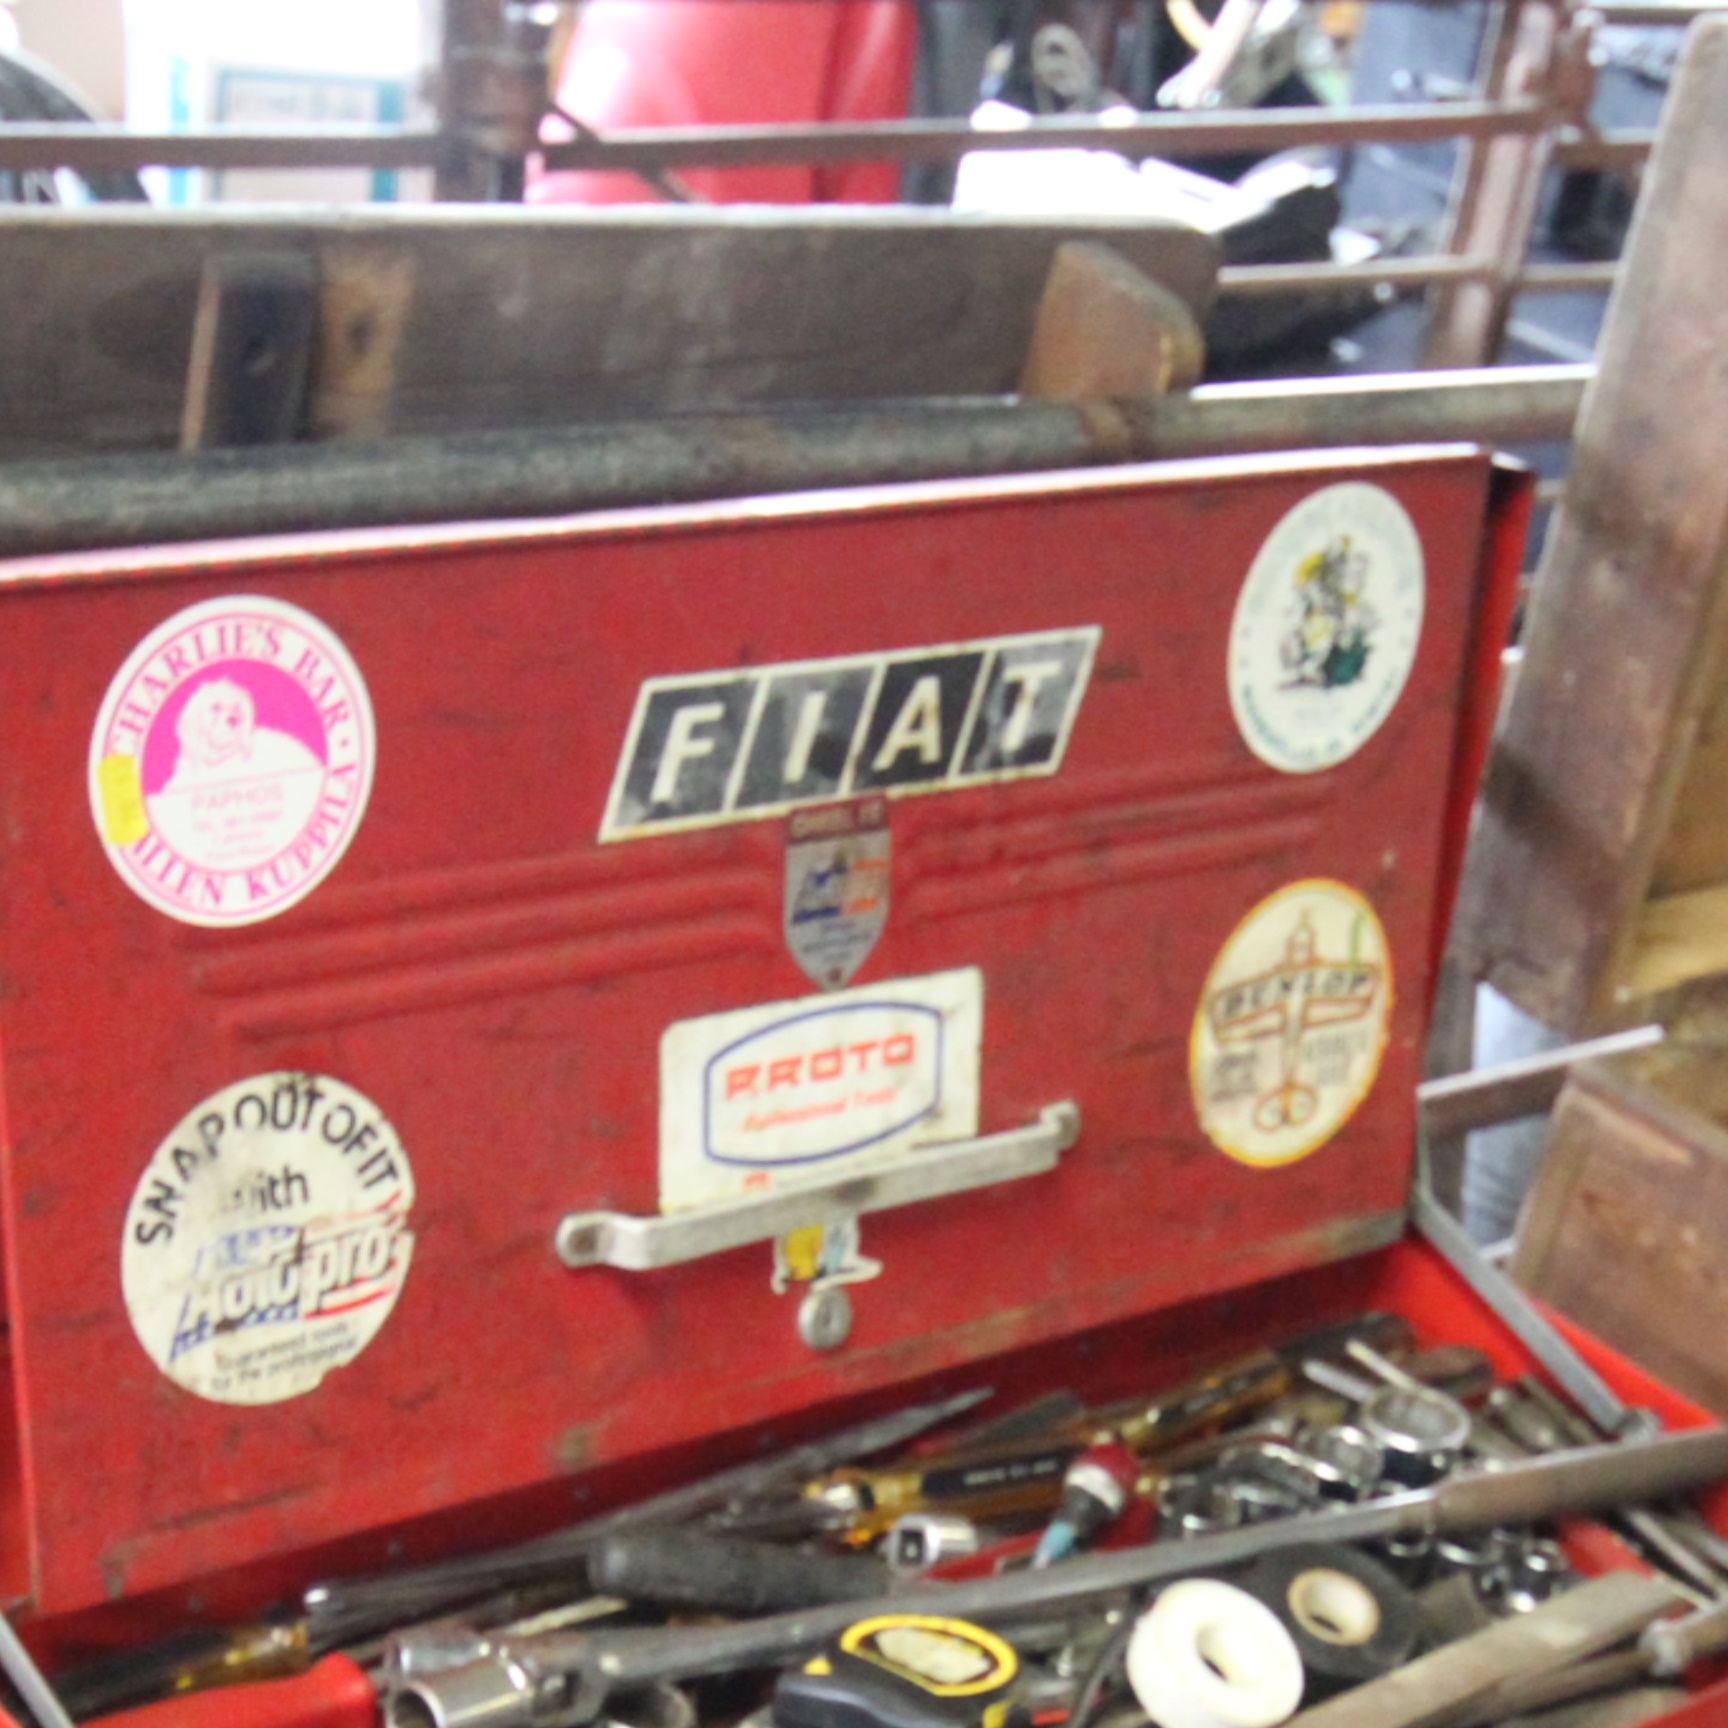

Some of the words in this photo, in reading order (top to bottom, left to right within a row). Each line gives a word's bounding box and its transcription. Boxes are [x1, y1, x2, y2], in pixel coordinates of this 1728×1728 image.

[293, 648, 352, 732] BAR
[650, 659, 1062, 803] FIAT
[725, 1032, 915, 1101] PROTO
[135, 1112, 226, 1248] SNAP
[234, 1080, 324, 1132] OUT
[322, 1102, 378, 1156] OF
[356, 1148, 399, 1190] IT
[222, 1164, 311, 1213] ith
